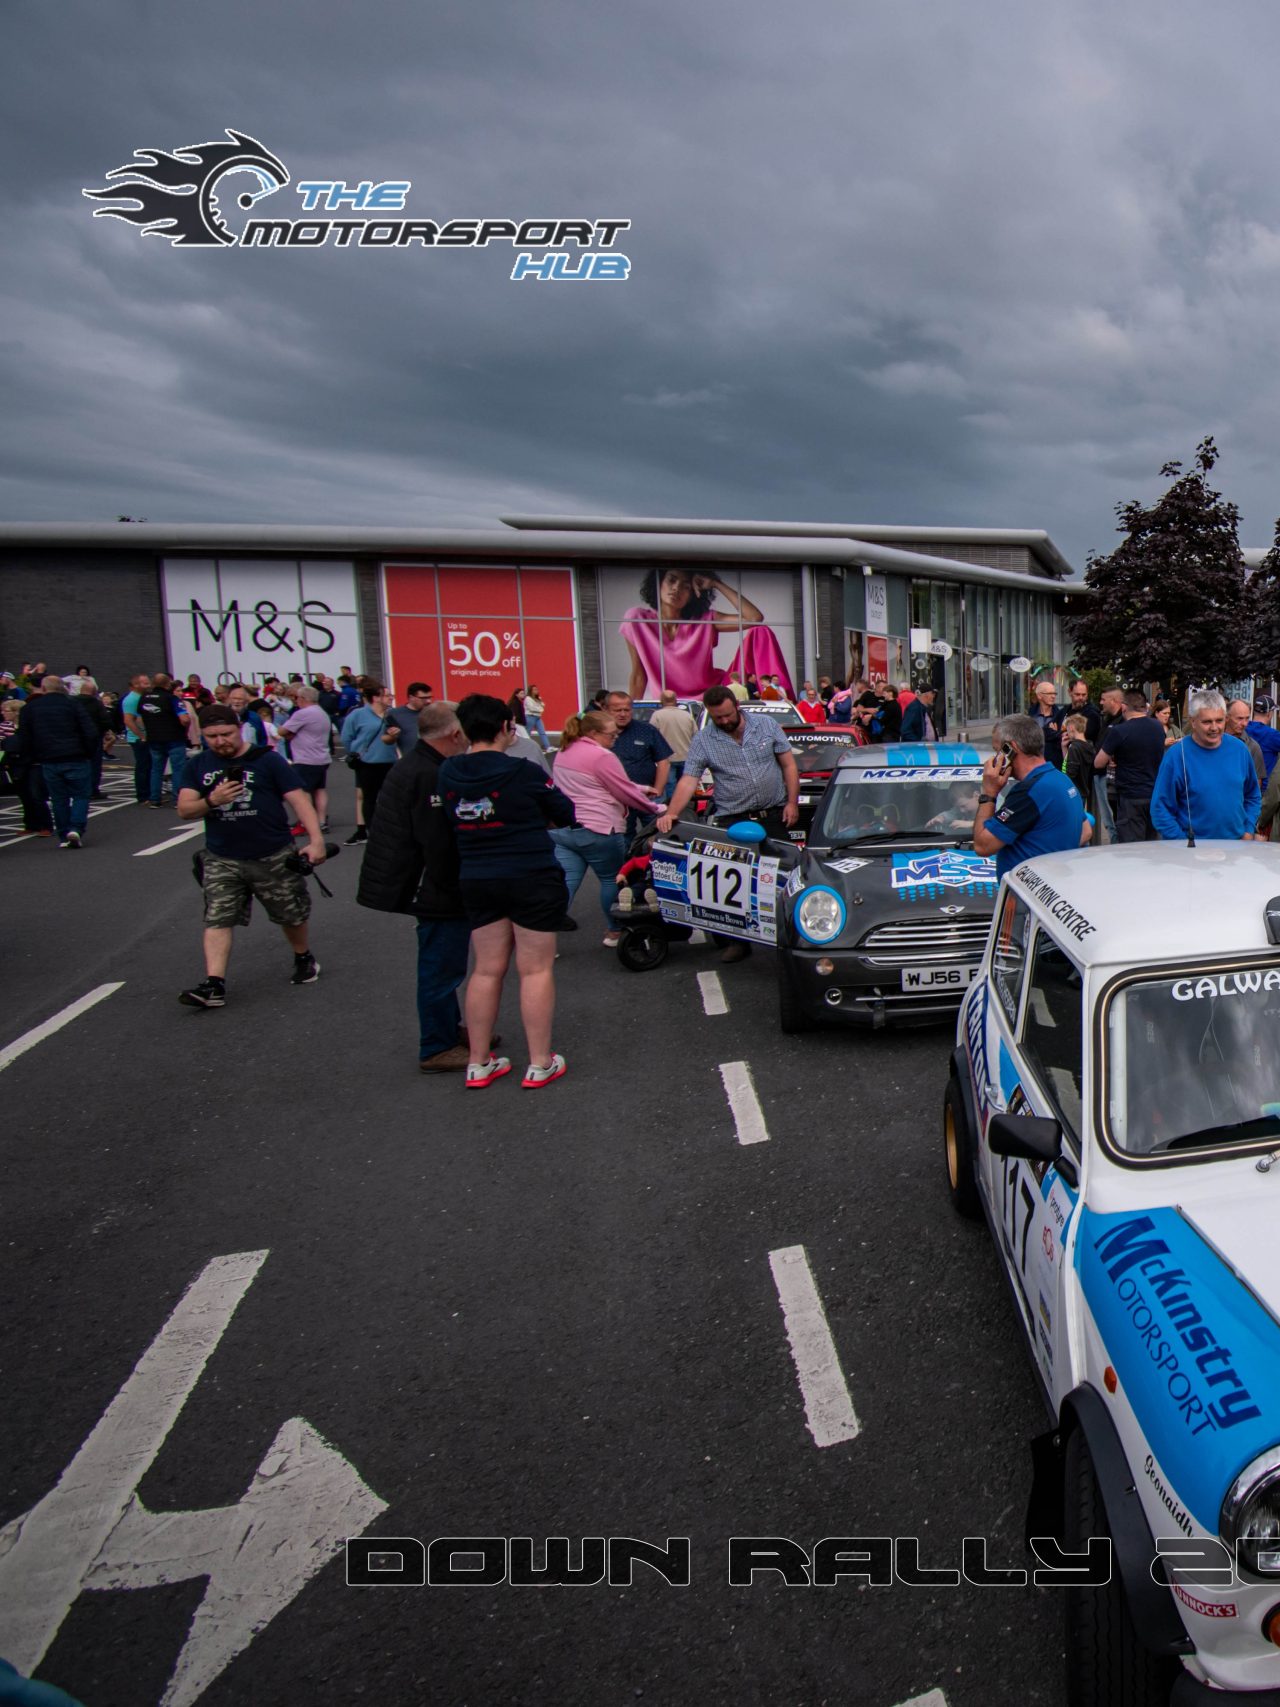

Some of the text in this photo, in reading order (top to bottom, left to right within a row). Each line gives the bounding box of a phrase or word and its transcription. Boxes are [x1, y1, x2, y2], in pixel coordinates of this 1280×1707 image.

[867, 583, 885, 606] M&S
[190, 599, 335, 654] M&S
[502, 656, 521, 668] off
[451, 669, 478, 677] original
[863, 768, 985, 778] MOFFET
[703, 845, 736, 860] RALLY
[690, 861, 743, 909] 112
[1015, 865, 1097, 942] GALWAY MINI CENTRE
[907, 970, 961, 986] WJ56
[1093, 1215, 1262, 1429] McKinstry
